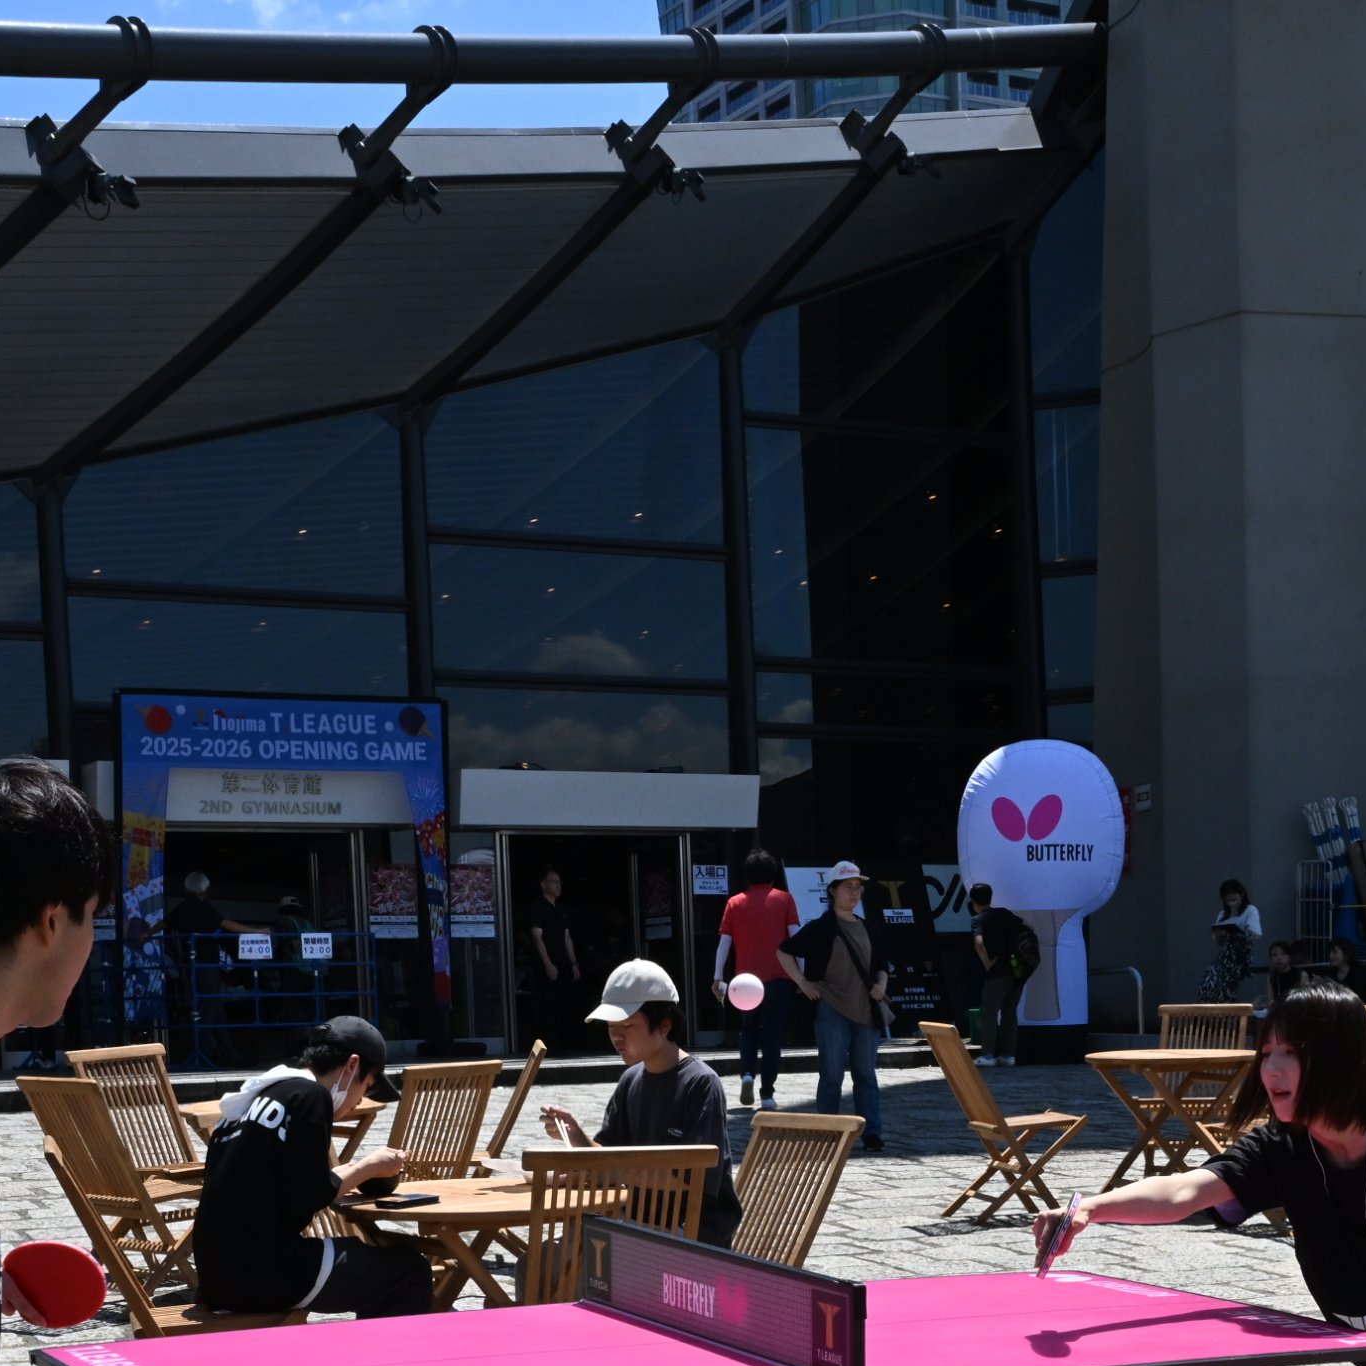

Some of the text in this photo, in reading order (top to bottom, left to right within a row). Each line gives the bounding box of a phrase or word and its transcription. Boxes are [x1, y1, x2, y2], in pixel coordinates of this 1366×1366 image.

[289, 713, 378, 735] LEAGUE
[140, 735, 428, 761] 2025-2026 OPENING GAME
[221, 773, 323, 795] 第二体育館
[199, 799, 342, 816] 2ND GYMNASIUM
[1026, 844, 1094, 862] BUTTERFLY
[695, 866, 726, 878] 入場口
[890, 916, 915, 924] LEAGUE
[662, 1272, 716, 1318] BUTTERFLY
